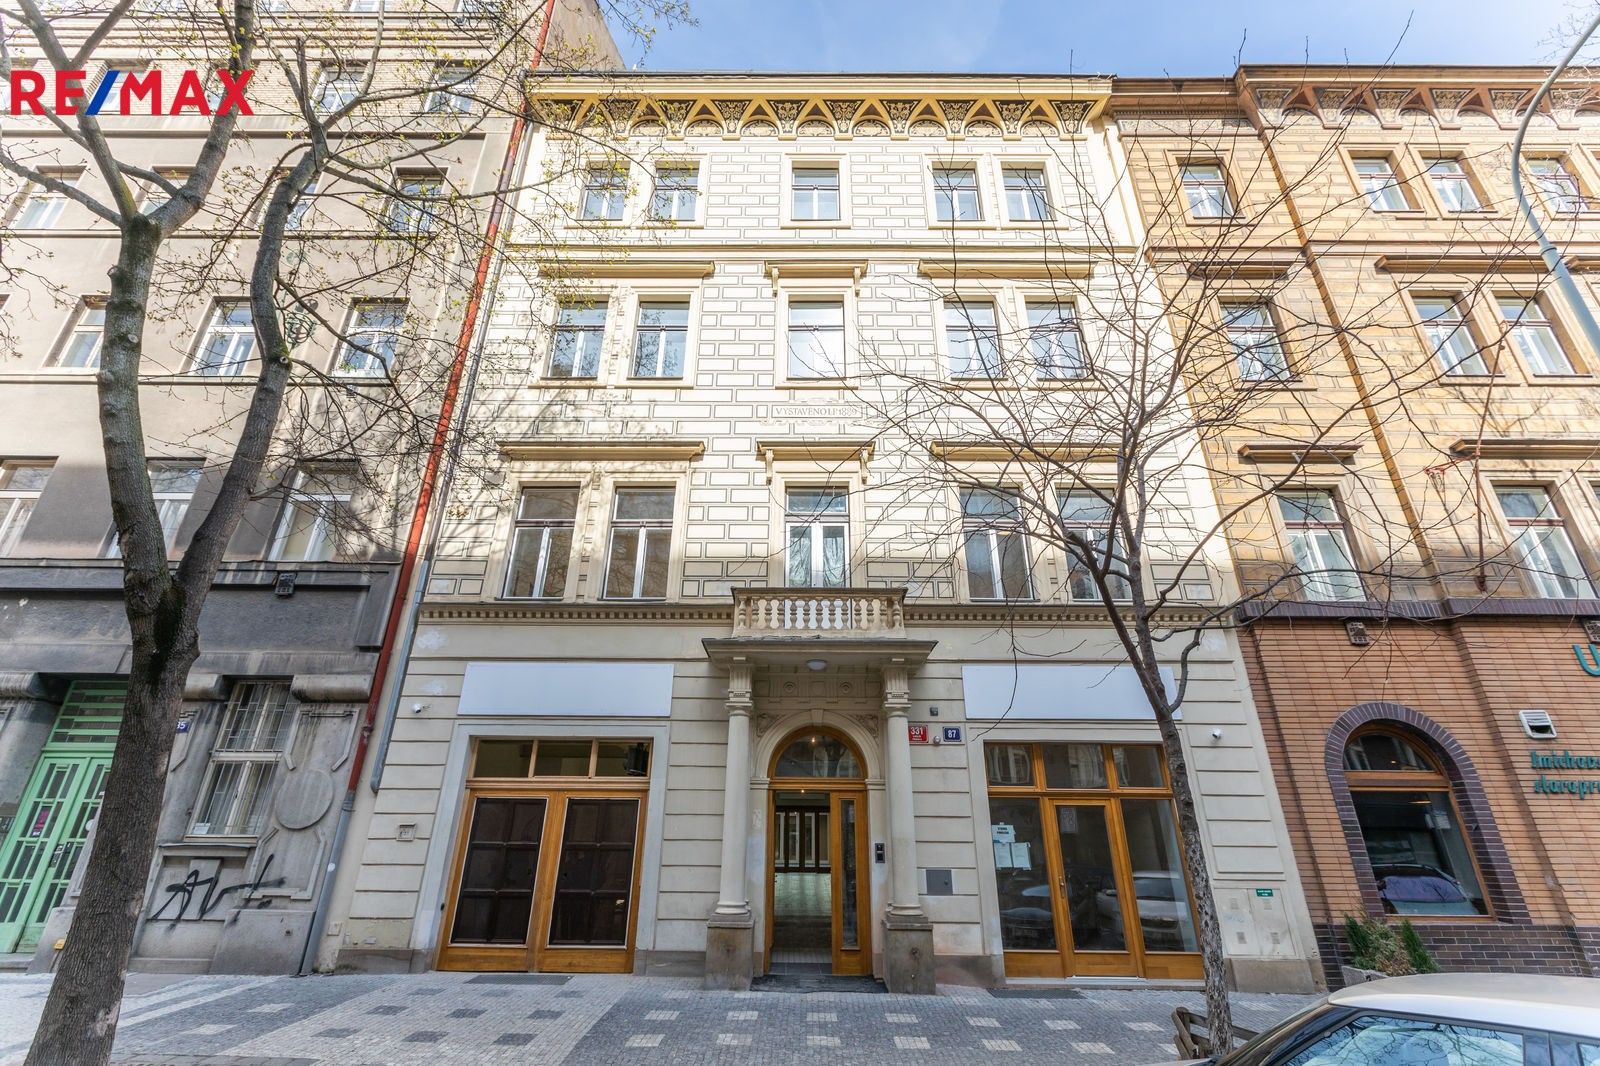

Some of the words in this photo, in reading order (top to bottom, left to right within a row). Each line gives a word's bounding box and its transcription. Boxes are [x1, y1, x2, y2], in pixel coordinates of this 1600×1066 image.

[775, 407, 827, 416] VYSTAVENO
[910, 726, 924, 735] 331
[947, 729, 957, 738] 87
